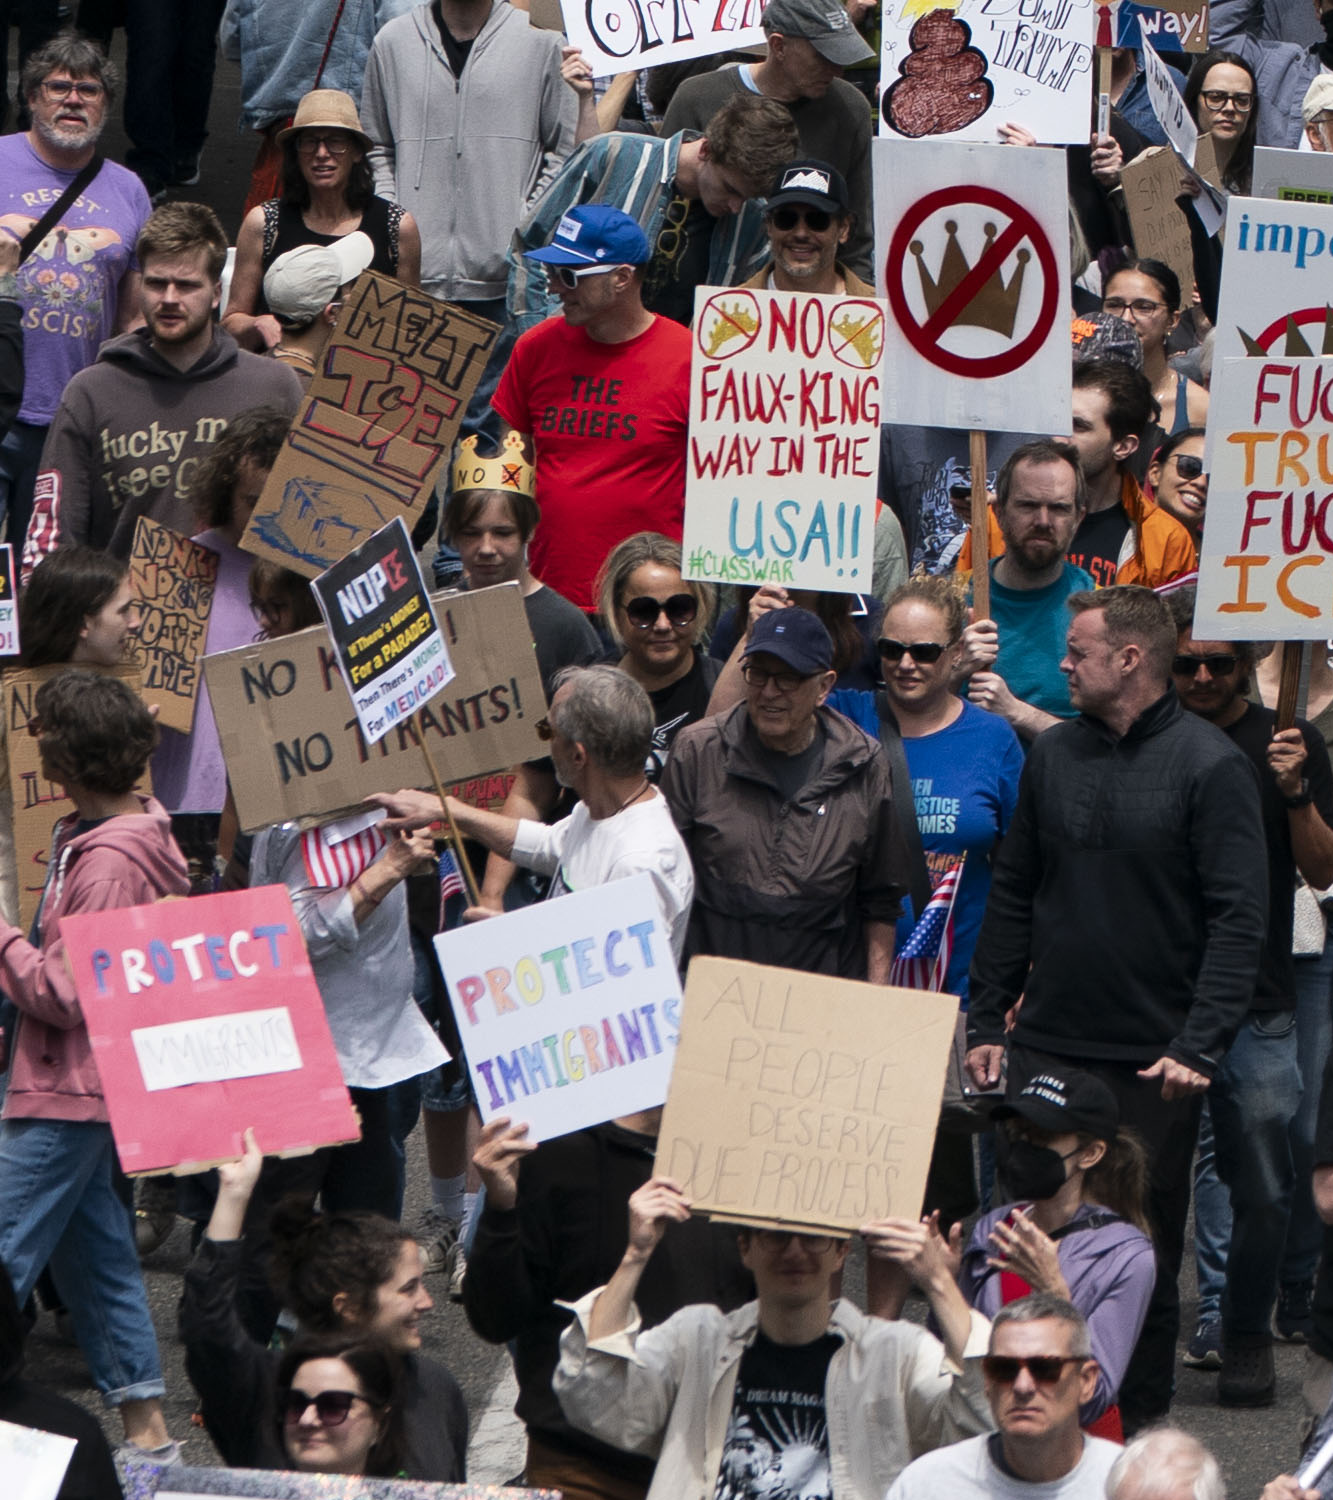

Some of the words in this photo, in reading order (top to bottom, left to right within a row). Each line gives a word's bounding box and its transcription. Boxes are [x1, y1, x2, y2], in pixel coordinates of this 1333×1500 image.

[769, 297, 823, 356] NO
[570, 376, 620, 405] THE
[699, 364, 881, 428] FAUX-KING
[541, 405, 636, 440] BRIEFS
[692, 436, 761, 479] WAY
[768, 438, 804, 476] IN
[812, 432, 873, 478] THE
[729, 497, 859, 576] USA!!
[456, 919, 655, 1024] PROTECT
[475, 1000, 681, 1111] IMMIGRANTS
